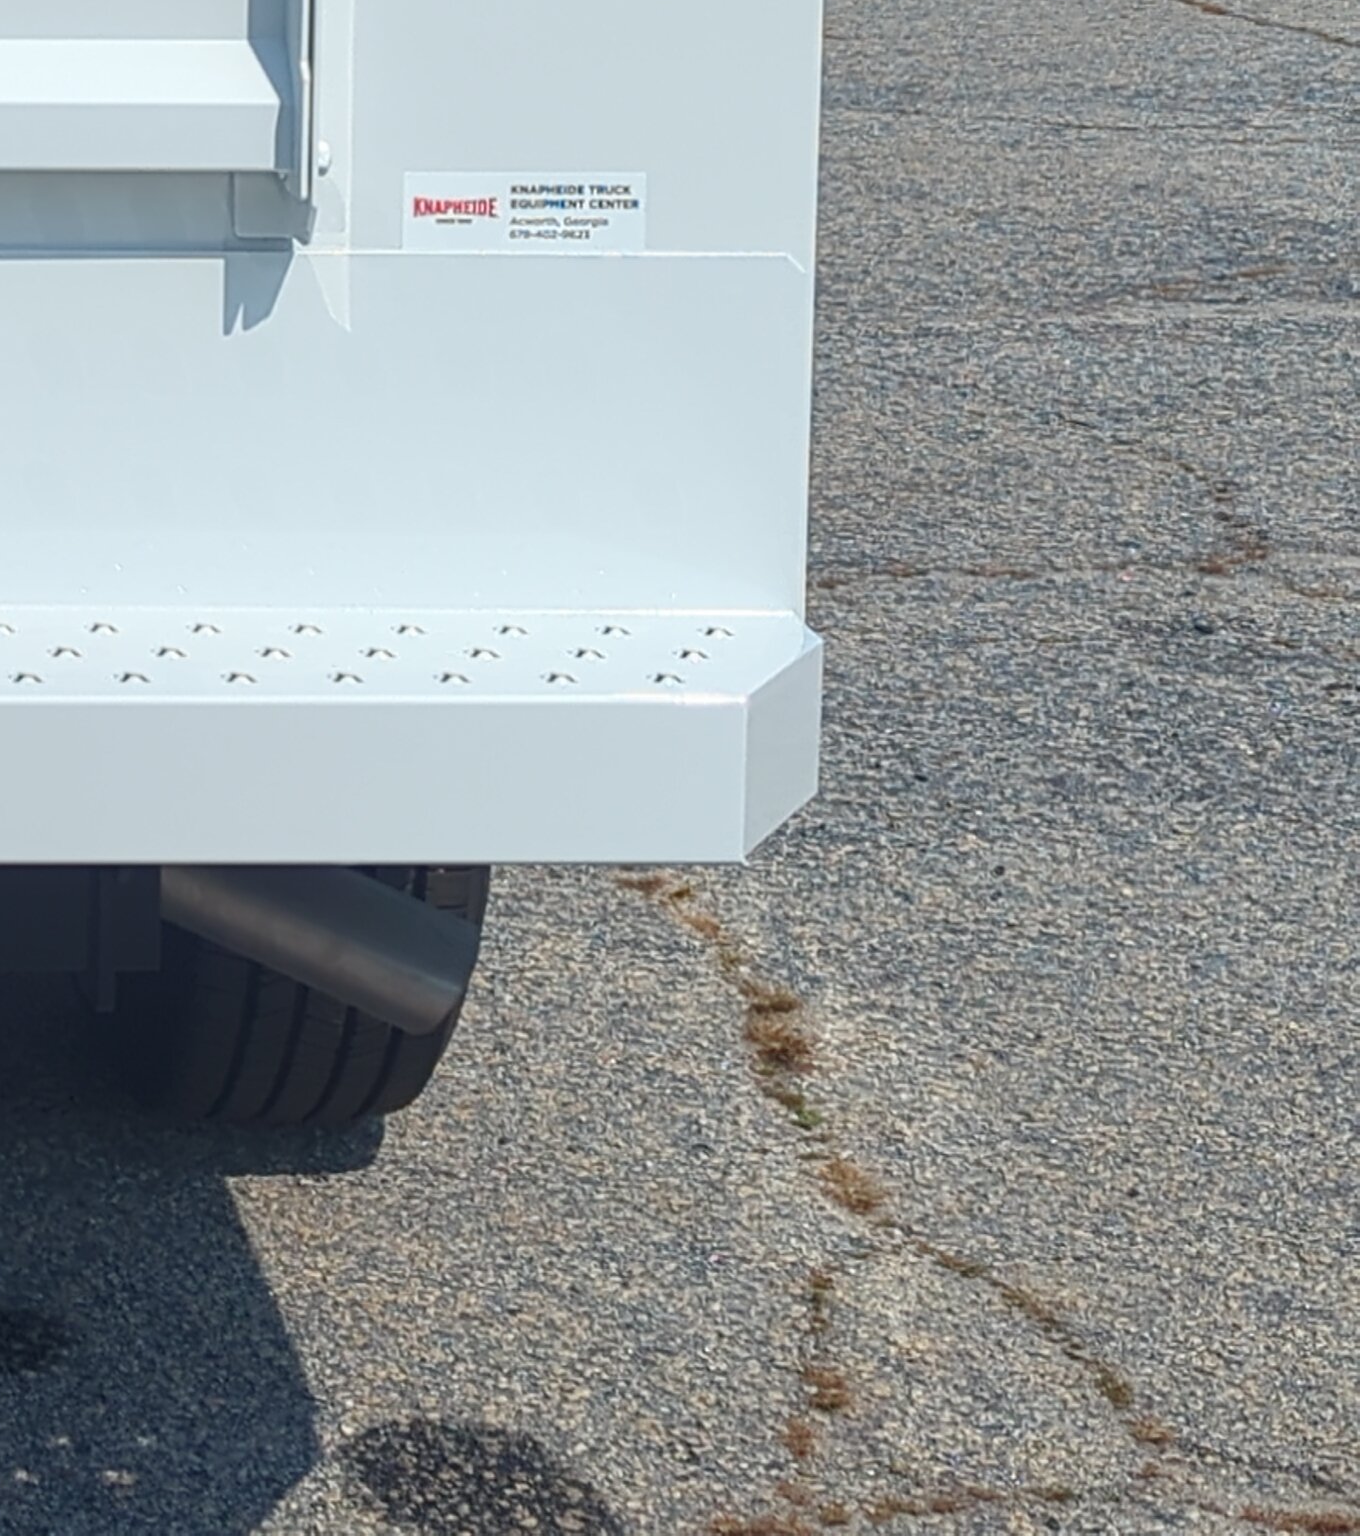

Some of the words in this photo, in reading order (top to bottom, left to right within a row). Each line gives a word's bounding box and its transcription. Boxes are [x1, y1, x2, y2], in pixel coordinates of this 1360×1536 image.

[510, 185, 584, 195] KNAPHEIDE
[589, 185, 631, 195] TRUCK
[413, 197, 498, 217] KNAPHEIDE
[510, 199, 584, 209] EQUIPMENT
[589, 199, 639, 209] CENTER
[509, 216, 560, 227] Acworth,
[563, 216, 609, 228] Georgia
